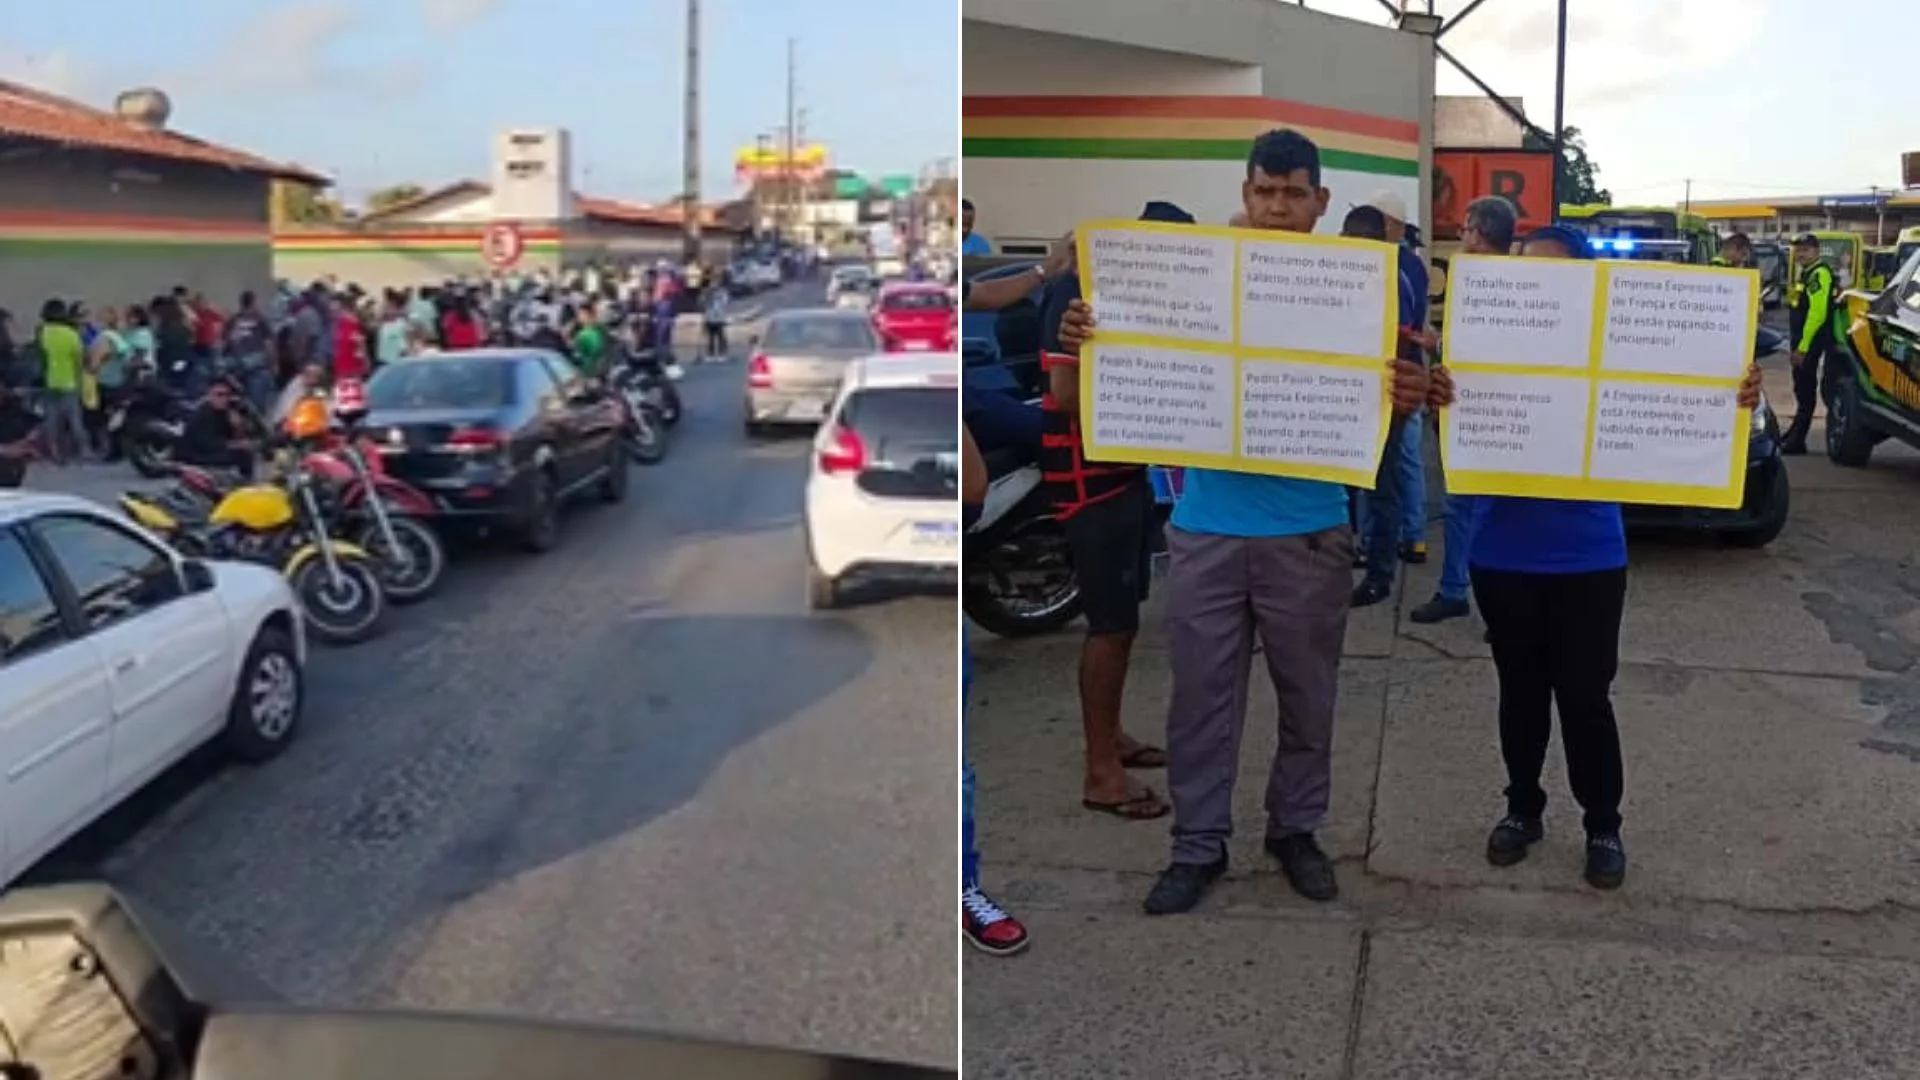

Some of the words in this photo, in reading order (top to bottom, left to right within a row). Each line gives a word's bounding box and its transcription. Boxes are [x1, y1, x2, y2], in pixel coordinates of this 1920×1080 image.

[1096, 240, 1142, 252] Atenção
[1096, 258, 1170, 272] competentes
[1173, 263, 1210, 275] olhem
[1250, 252, 1314, 268] Precisamos
[1318, 258, 1338, 269] dos
[1341, 261, 1378, 273] nossos
[1127, 280, 1151, 289] para
[1464, 277, 1513, 290] Trabalho
[1515, 282, 1540, 290] com
[1613, 277, 1662, 292] Empresa
[1665, 280, 1713, 293] Expresso
[1265, 293, 1295, 304] nossa
[1612, 296, 1627, 307] de
[1629, 296, 1665, 311] França
[1169, 301, 1189, 312] que
[1193, 302, 1212, 312] são
[1165, 316, 1180, 327] de
[1462, 316, 1485, 325] com
[1610, 314, 1632, 325] não
[1667, 319, 1716, 332] pagando
[1718, 323, 1731, 332] os
[1099, 355, 1132, 367] Pedro
[1136, 357, 1166, 369] Paulo
[1201, 364, 1214, 375] da
[1247, 373, 1279, 384] Pedro
[1282, 373, 1313, 385] Paulo
[1099, 392, 1113, 402] de
[1245, 391, 1291, 404] Empresa
[1461, 388, 1518, 401] Queremos
[1520, 393, 1552, 403] nossa
[1612, 390, 1660, 404] Empresa
[1681, 396, 1703, 406] que
[1706, 396, 1726, 407] não
[1145, 414, 1177, 426] pagar
[1626, 409, 1684, 421] recebendo
[1458, 423, 1506, 434] pagaram
[1510, 425, 1530, 434] 230
[1646, 426, 1659, 436] da
[1247, 444, 1276, 457] pagar
